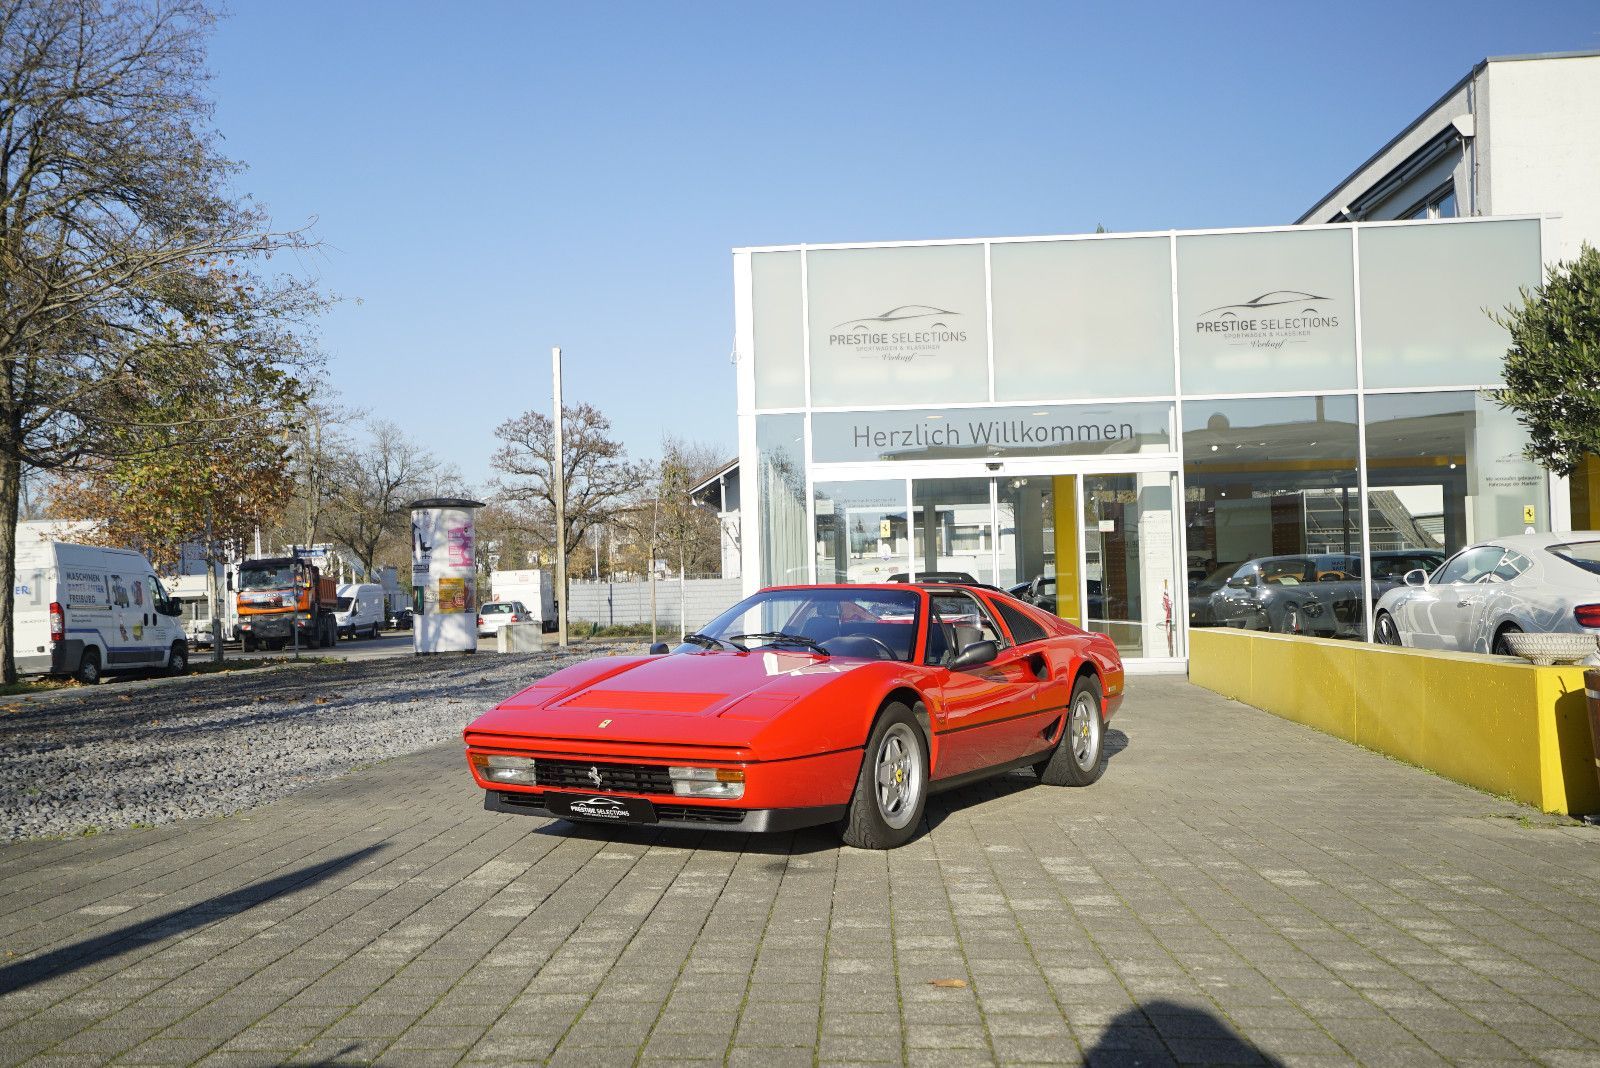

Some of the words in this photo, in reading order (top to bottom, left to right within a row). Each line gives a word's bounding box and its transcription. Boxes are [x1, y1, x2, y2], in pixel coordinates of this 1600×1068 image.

[1196, 320, 1257, 333] PRESTIGE
[1260, 316, 1339, 330] SELECTIONS
[829, 333, 888, 346] PRESTIGE
[891, 331, 967, 343] SELECTIONS
[853, 423, 960, 448] Herzlich
[968, 421, 1134, 444] Willkommen
[66, 572, 101, 582] MASCHINEN
[69, 594, 96, 604] FREIBURG
[596, 808, 630, 817] SELECTIONS
